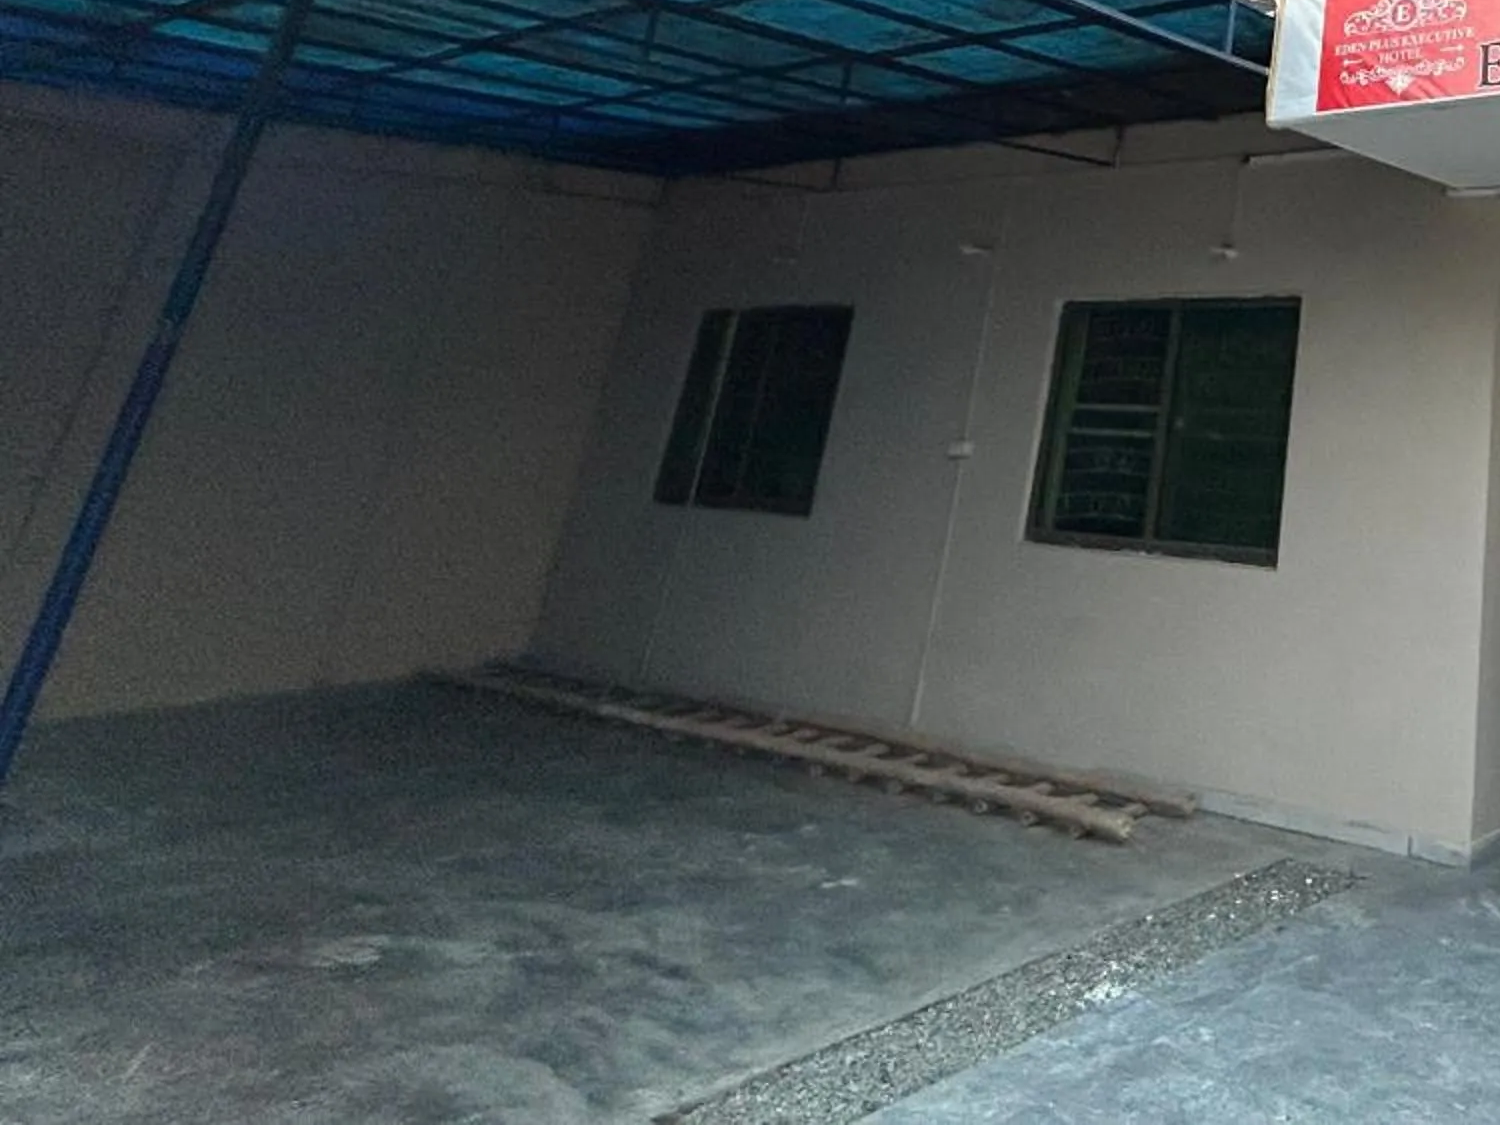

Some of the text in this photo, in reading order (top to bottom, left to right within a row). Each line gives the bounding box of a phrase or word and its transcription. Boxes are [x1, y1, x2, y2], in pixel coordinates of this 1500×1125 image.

[1335, 26, 1475, 56] EDEN PLUS EXECUTIVE
[1378, 48, 1423, 65] HOTEL
